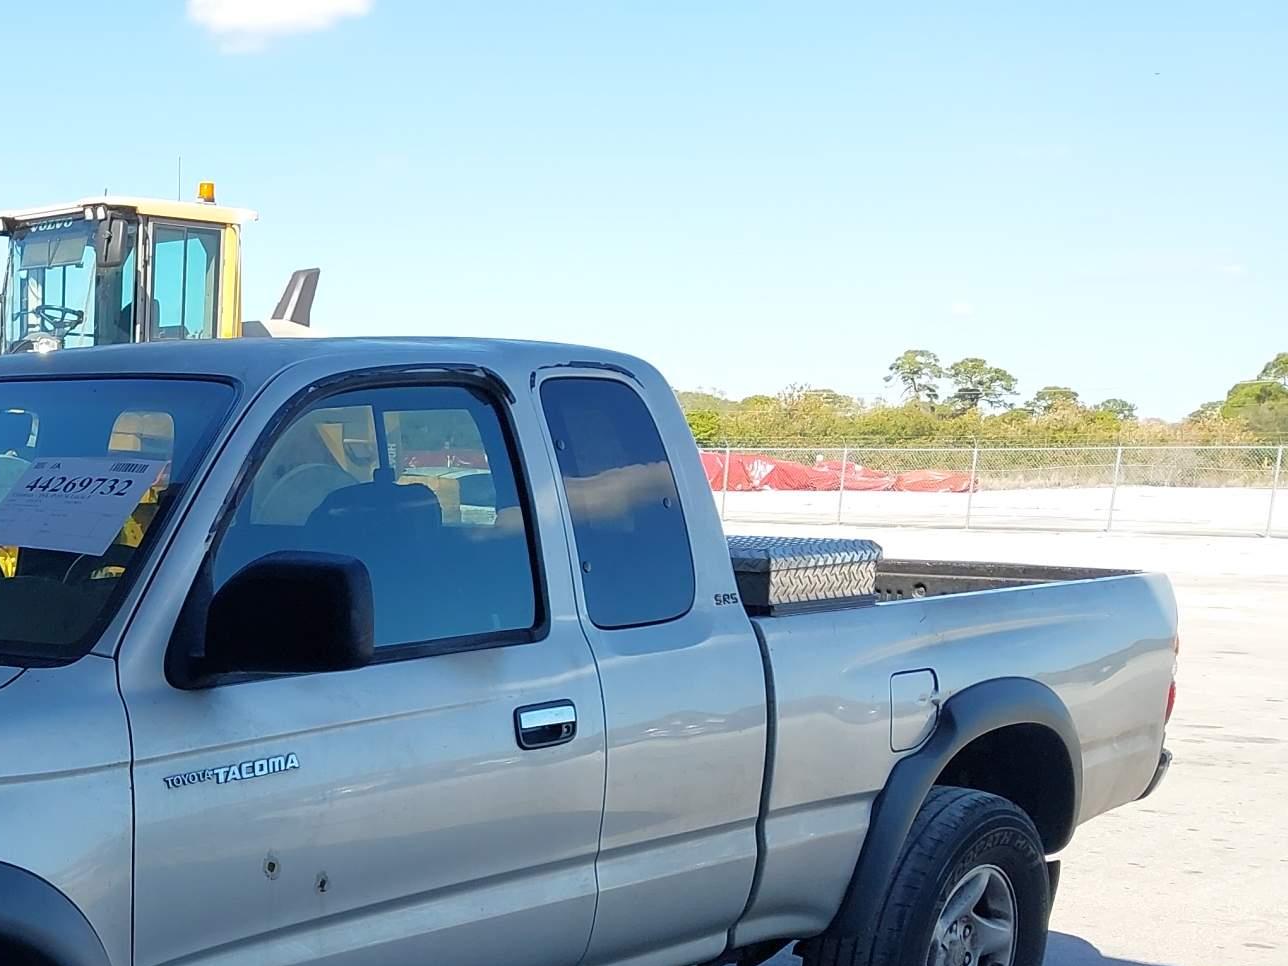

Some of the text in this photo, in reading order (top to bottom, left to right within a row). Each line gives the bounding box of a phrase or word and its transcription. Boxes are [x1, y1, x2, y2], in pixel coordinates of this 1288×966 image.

[30, 217, 73, 233] VOLVO
[25, 475, 133, 497] 44269732
[164, 752, 300, 789] TOYOTA TACOMA
